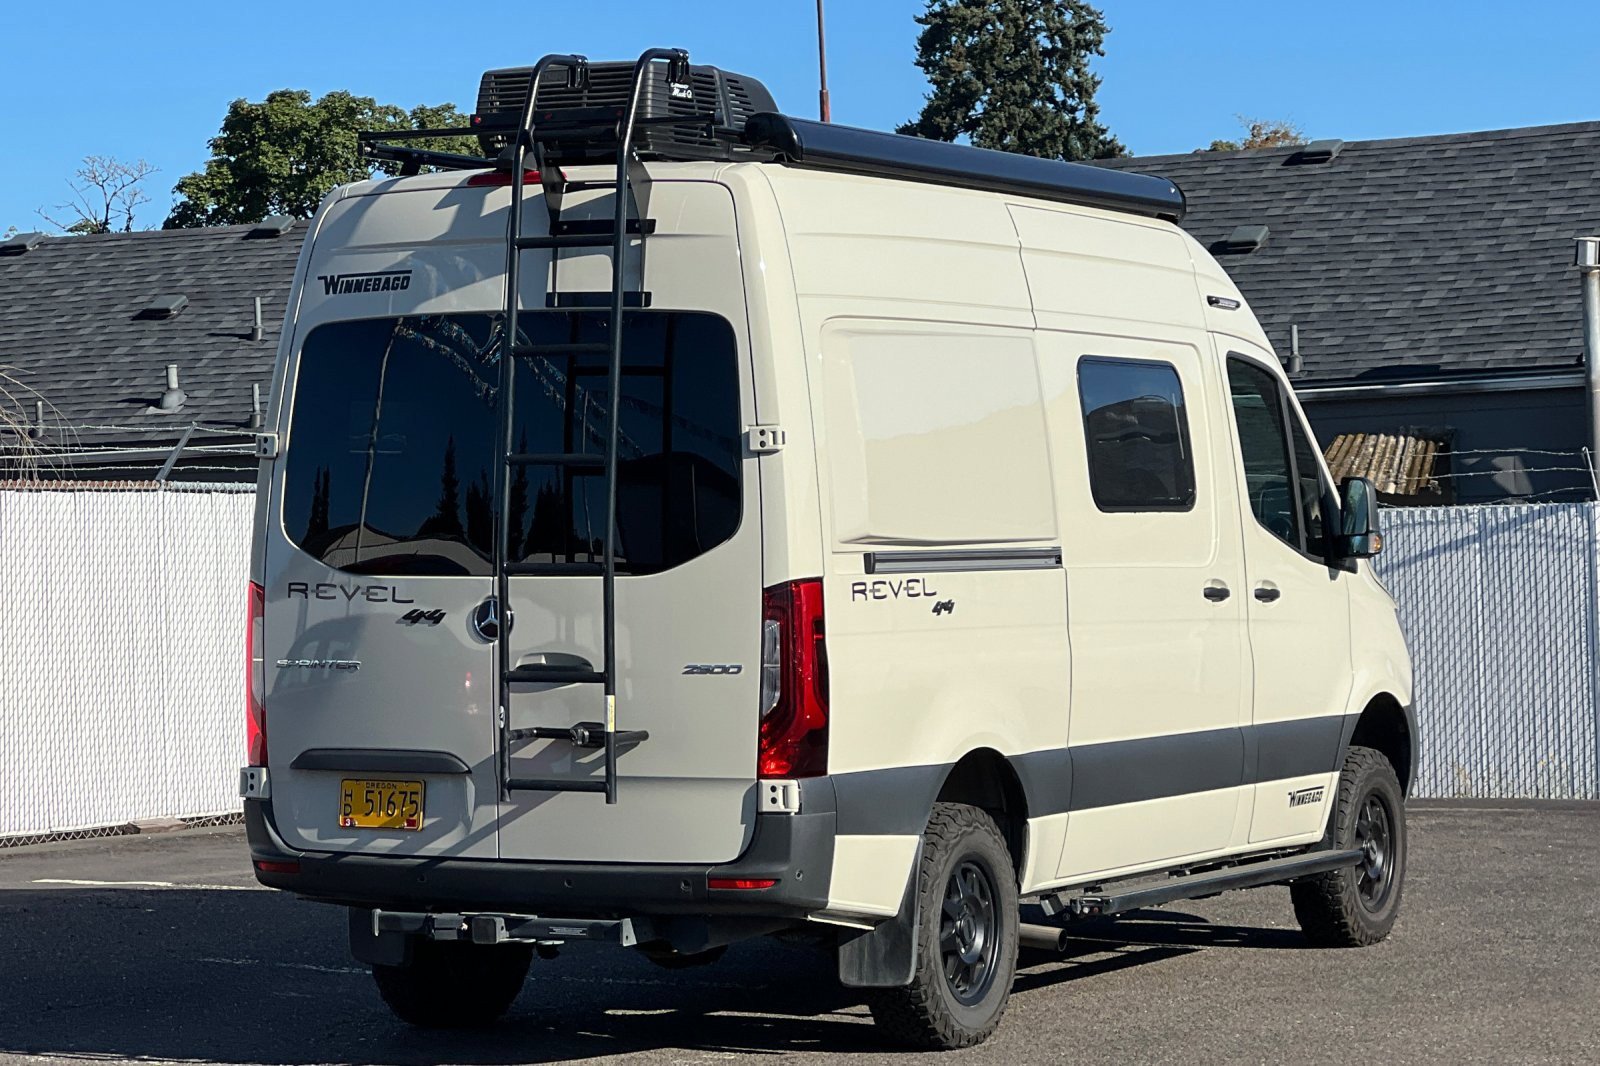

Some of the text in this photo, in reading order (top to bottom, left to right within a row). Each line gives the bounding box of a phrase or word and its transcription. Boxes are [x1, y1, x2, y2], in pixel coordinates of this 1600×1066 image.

[317, 269, 413, 295] WINNEBAGO
[287, 582, 414, 604] REVEL
[851, 578, 937, 602] REVEL
[276, 658, 362, 671] SPRINTER
[682, 664, 743, 675] 2500
[364, 789, 419, 818] 51675
[1288, 785, 1325, 808] WINNEBAGO
